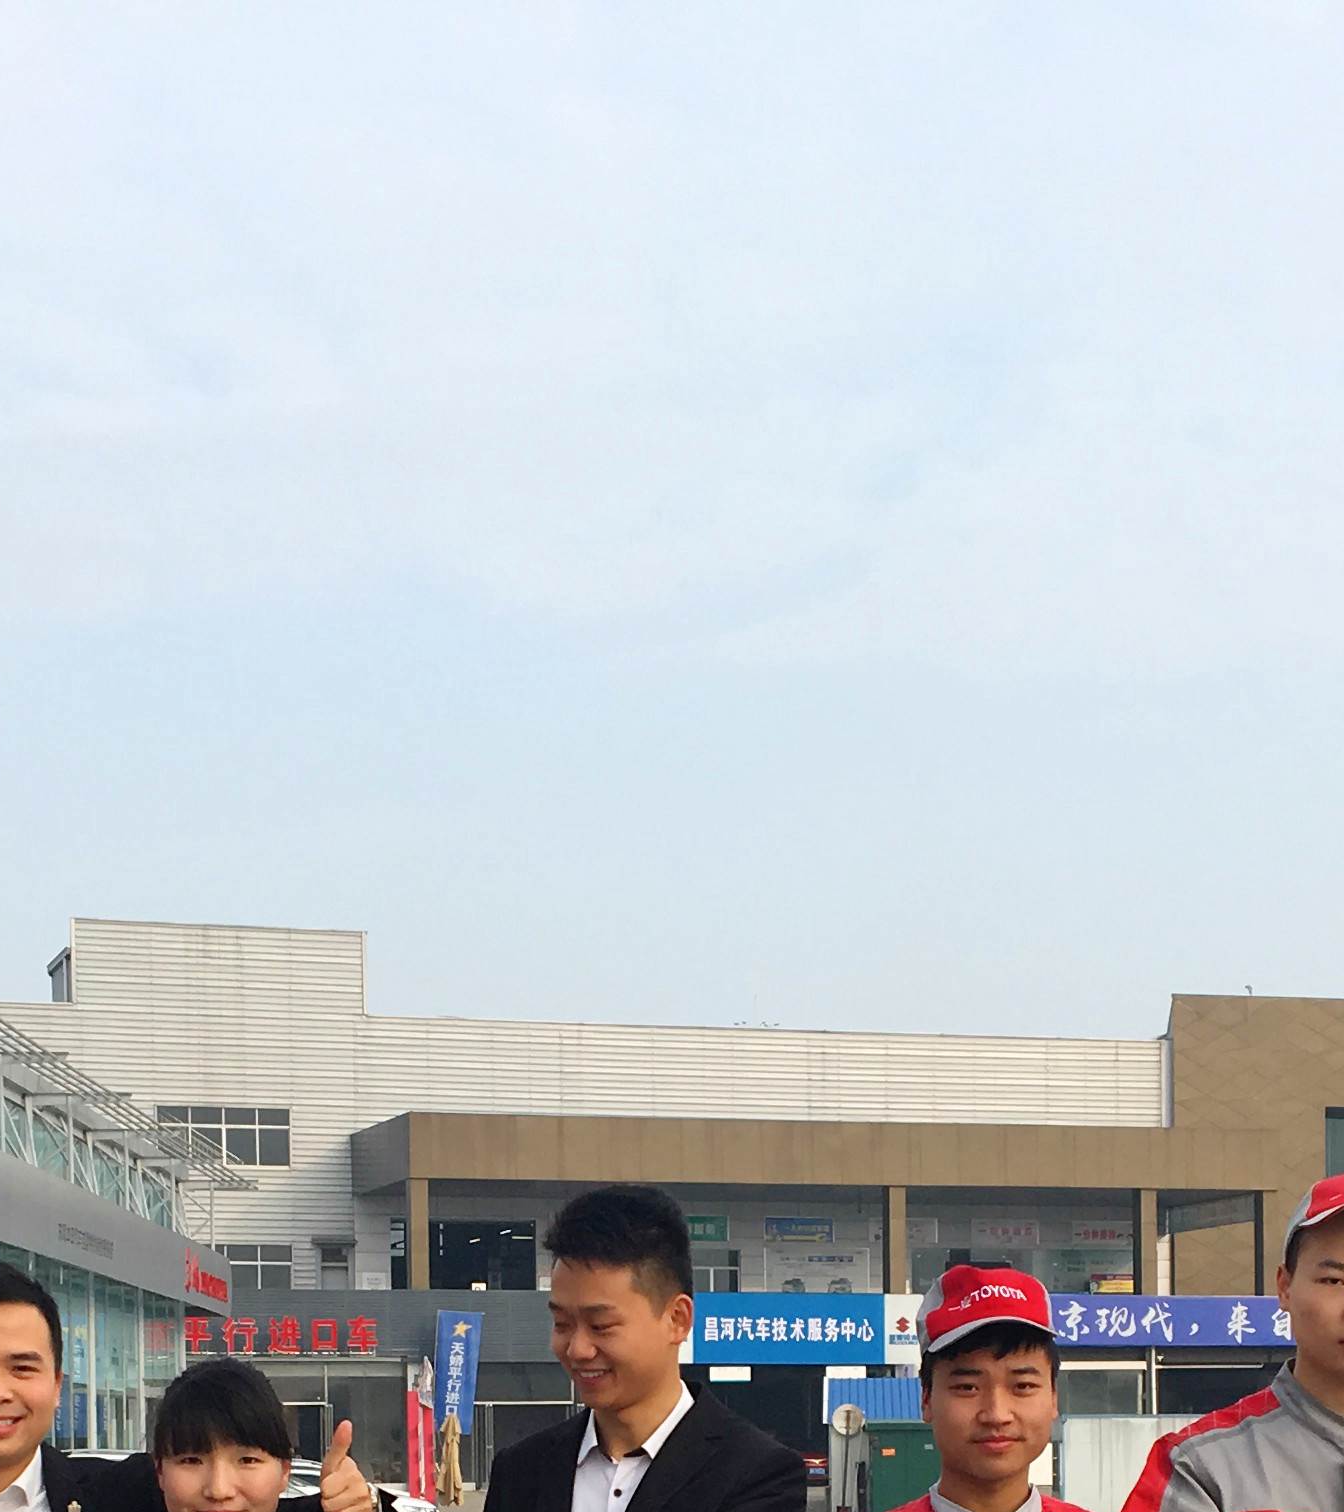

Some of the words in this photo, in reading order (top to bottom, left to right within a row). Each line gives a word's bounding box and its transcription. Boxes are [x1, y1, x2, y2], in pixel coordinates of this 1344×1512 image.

[970, 1284, 1028, 1302] TOYOTA
[184, 1314, 379, 1355] 平行进口车
[704, 1316, 875, 1342] 昌河汽车技术服务中心
